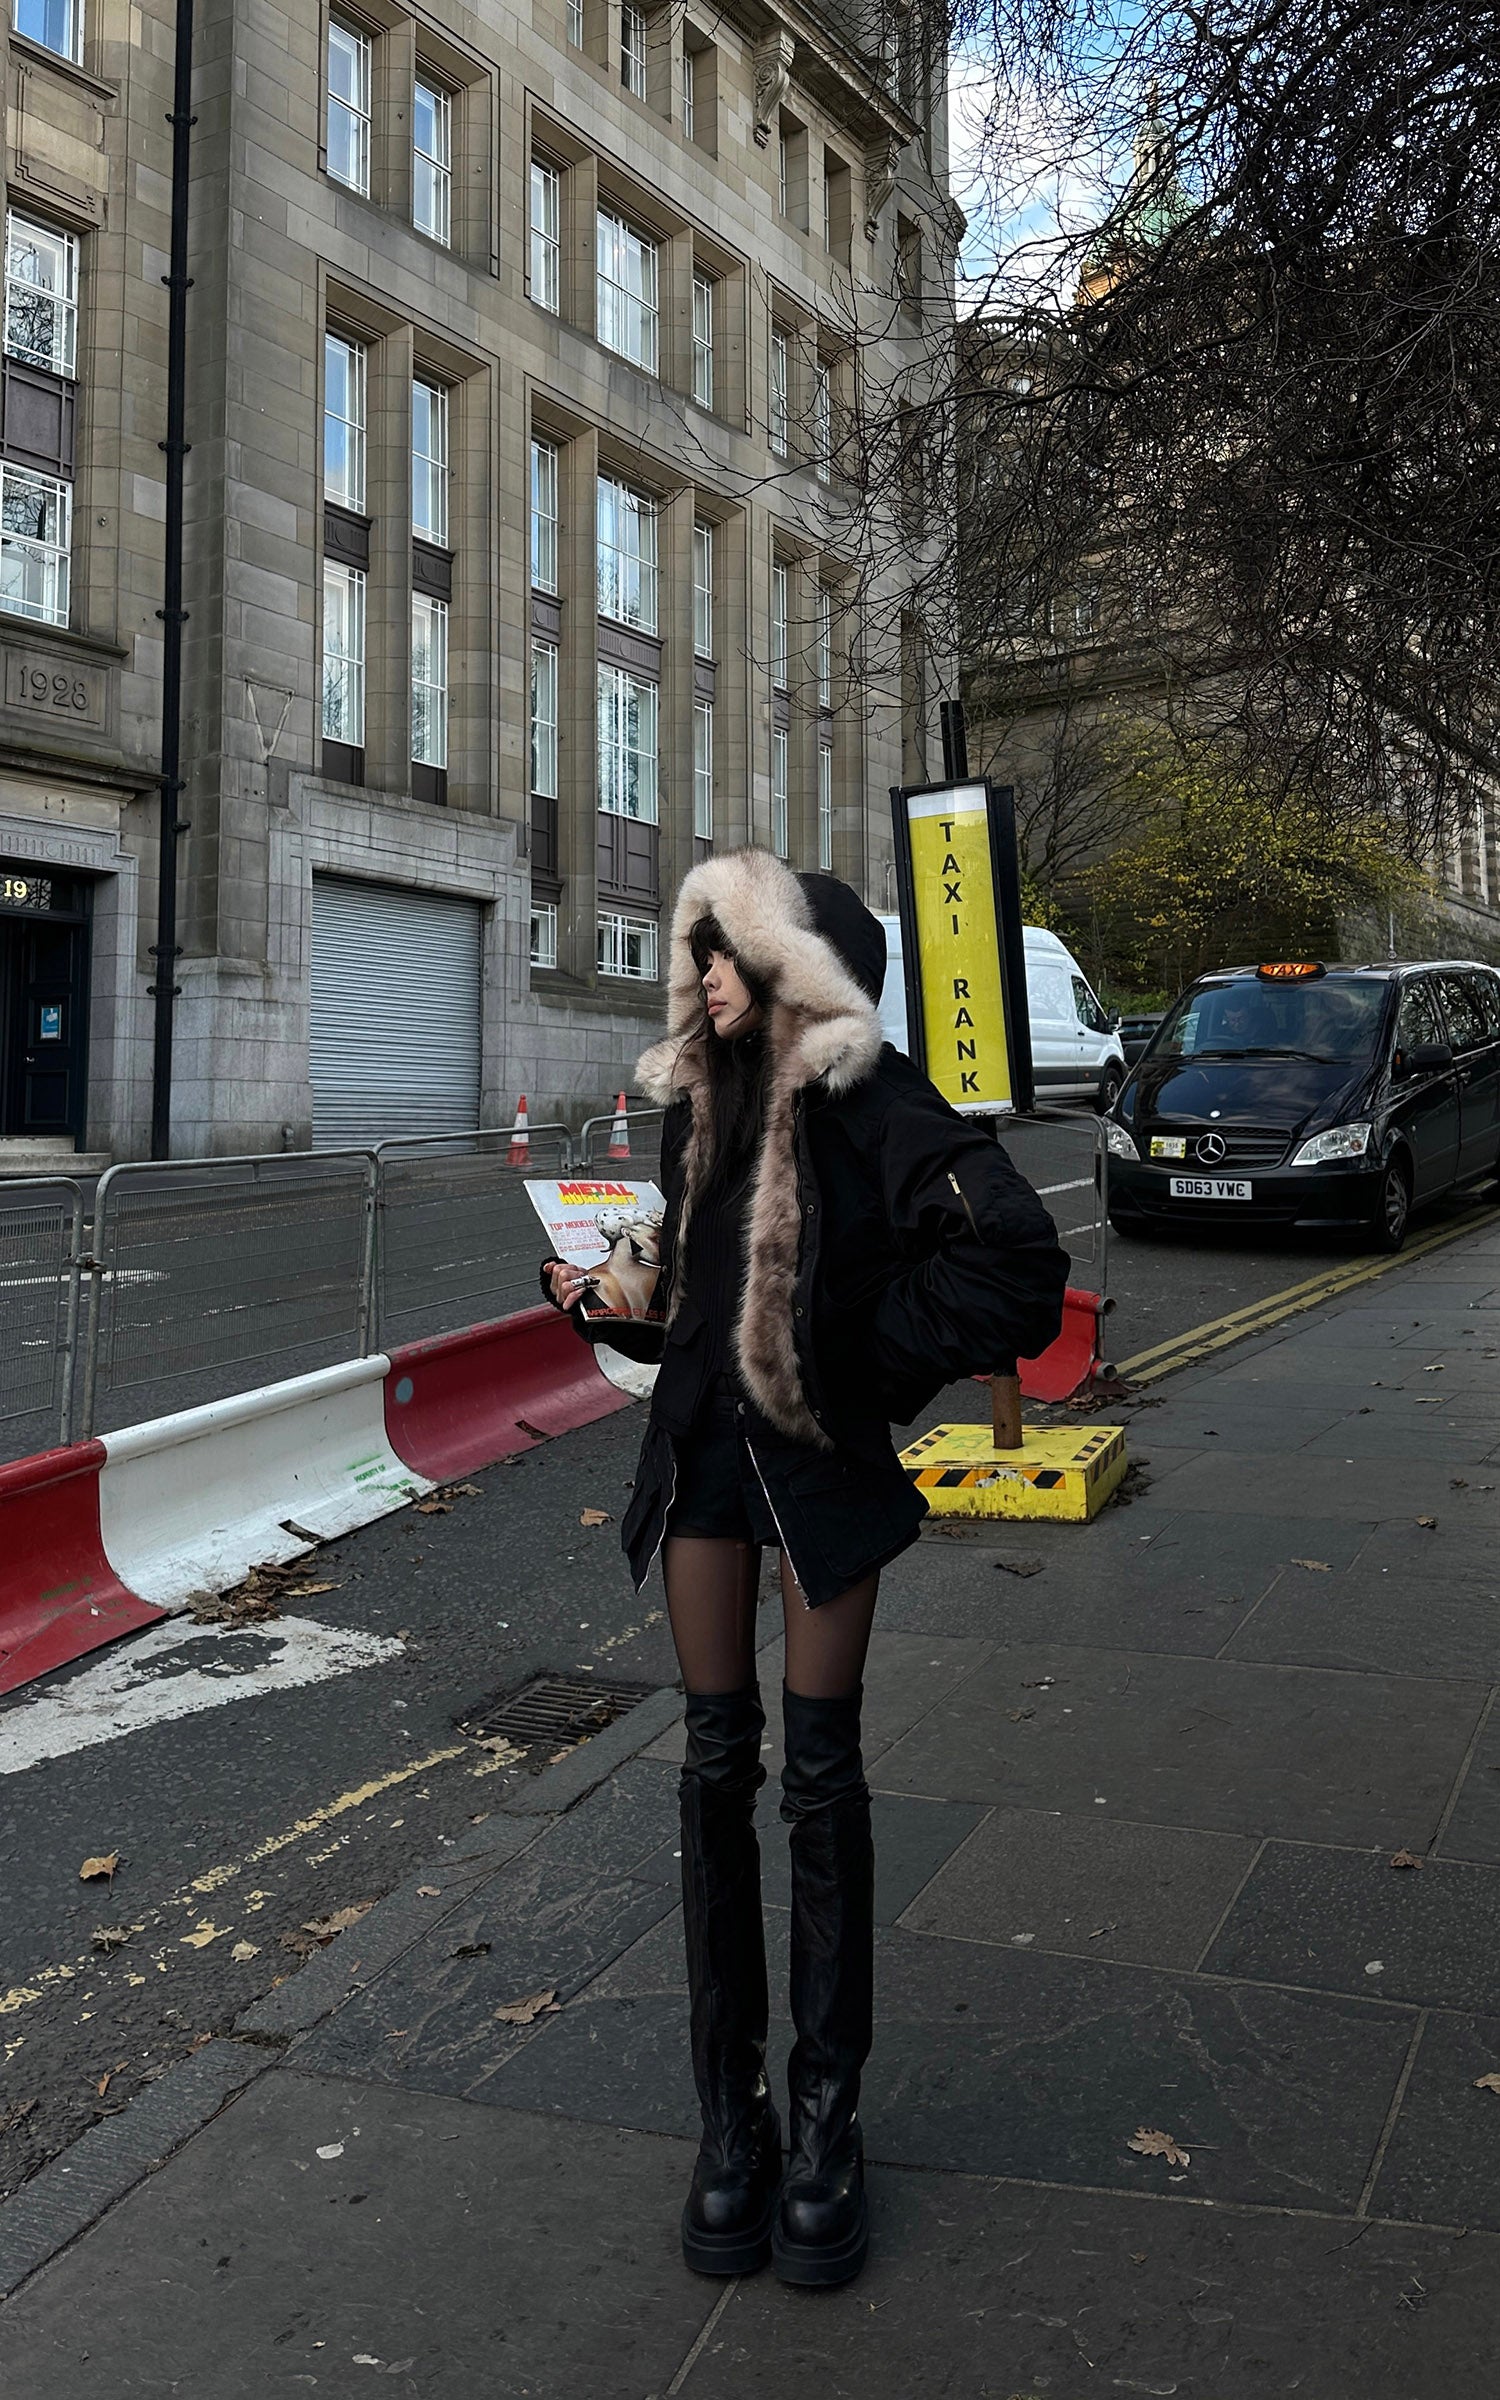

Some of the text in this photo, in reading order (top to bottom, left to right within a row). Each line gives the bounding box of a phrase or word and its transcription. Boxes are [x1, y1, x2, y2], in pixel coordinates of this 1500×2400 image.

[20, 665, 89, 710] 1928
[3, 879, 28, 899] 19
[939, 820, 981, 1094] TAXI RANK
[1270, 964, 1305, 976] TAXI
[557, 1182, 634, 1195] METAL
[1175, 1180, 1246, 1197] SD63 VWC
[548, 1219, 595, 1231] TOP MODELS
